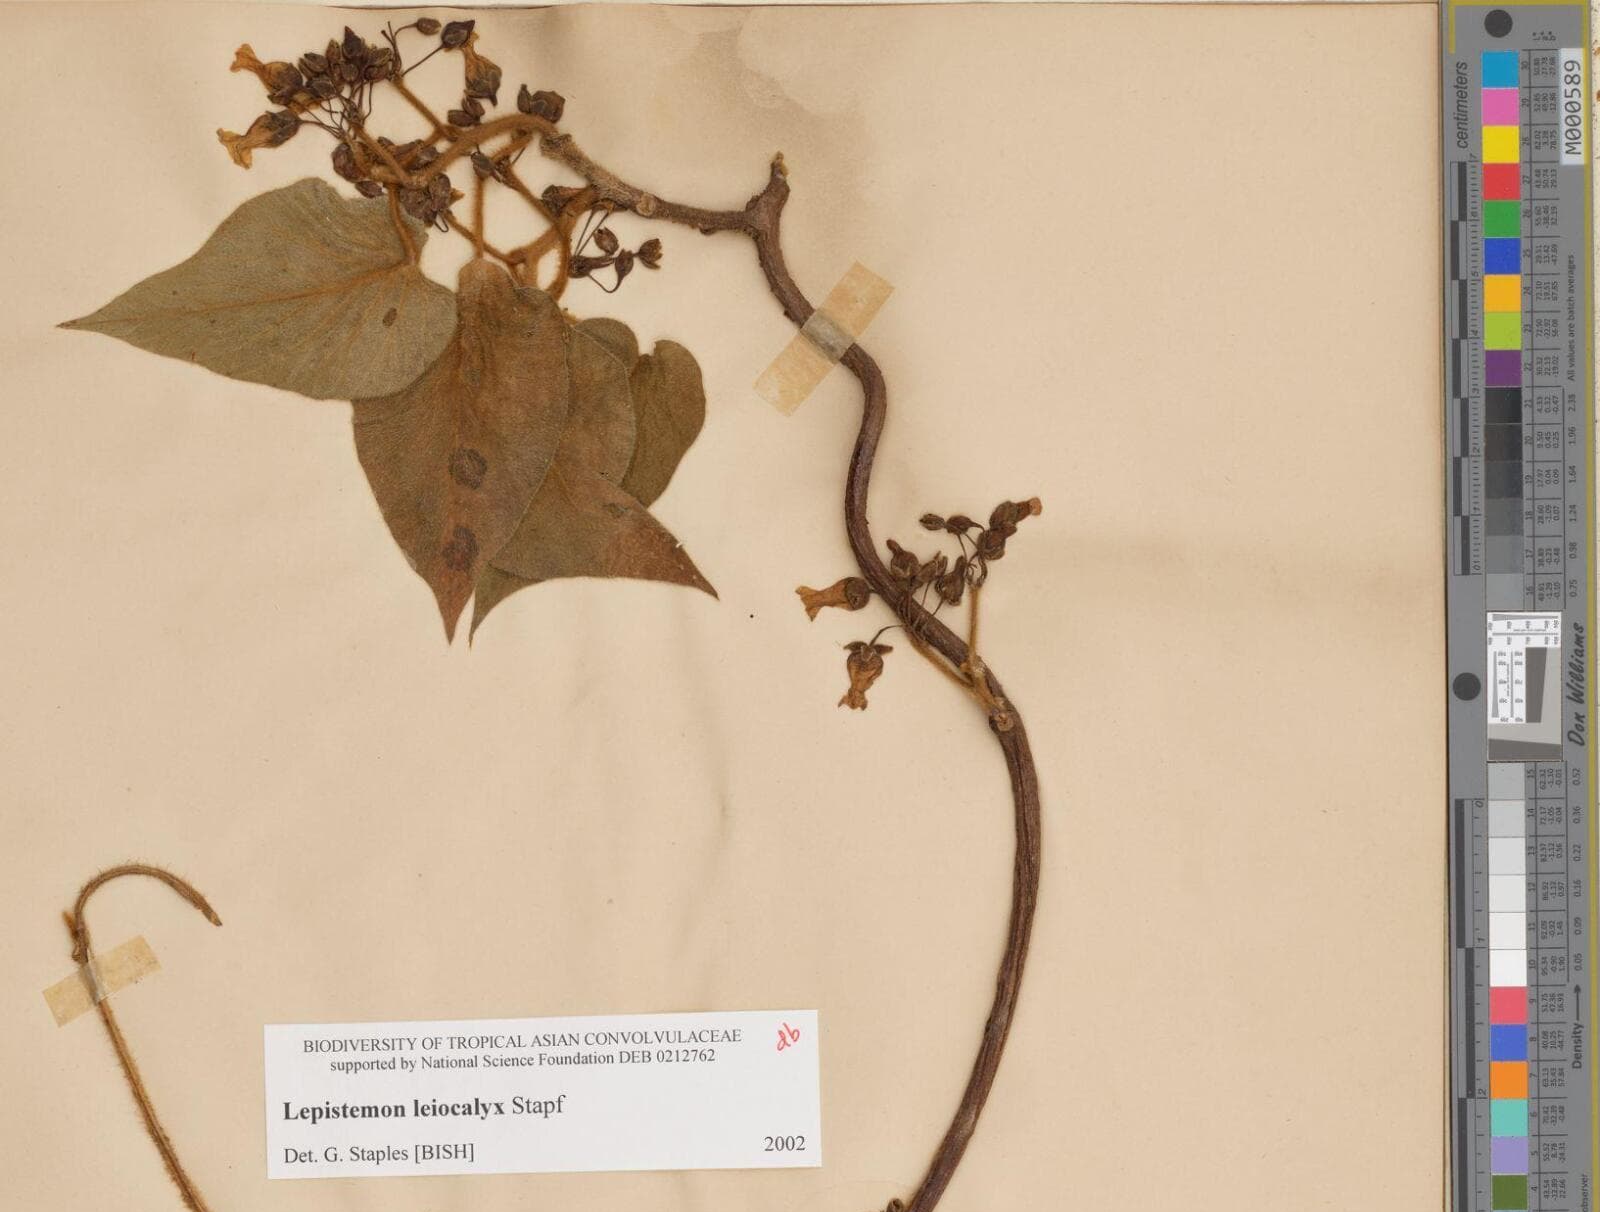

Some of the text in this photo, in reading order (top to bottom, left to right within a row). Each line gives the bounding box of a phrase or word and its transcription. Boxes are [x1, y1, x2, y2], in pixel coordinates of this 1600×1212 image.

[1453, 61, 1470, 148] centimeters
[1564, 59, 1581, 154] M000589
[1567, 254, 1575, 293] averages
[1567, 370, 1575, 381] All
[1569, 504, 1577, 522] 1.24
[1569, 578, 1577, 597] 0.75
[1566, 621, 1585, 746] Don Williams
[1573, 767, 1581, 785] 0.52
[1573, 805, 1581, 823] 0.36
[1573, 843, 1581, 861] 0.22
[1574, 916, 1582, 935] 0.09
[1574, 952, 1582, 971] 0.05
[303, 1029, 742, 1053] BIODIVERSITY OF TROPICAL ASIAN CONVOLVULACEAE
[1572, 1022, 1584, 1068] Density
[330, 1048, 716, 1073] supported by National Science Foundation DEB 0212762
[283, 1095, 566, 1124] Lepistemon leiocalyx Stapf
[284, 1142, 475, 1164] Det. G. Staples [BISH]
[763, 1136, 806, 1152] 2002
[1580, 1173, 1589, 1212] observer
